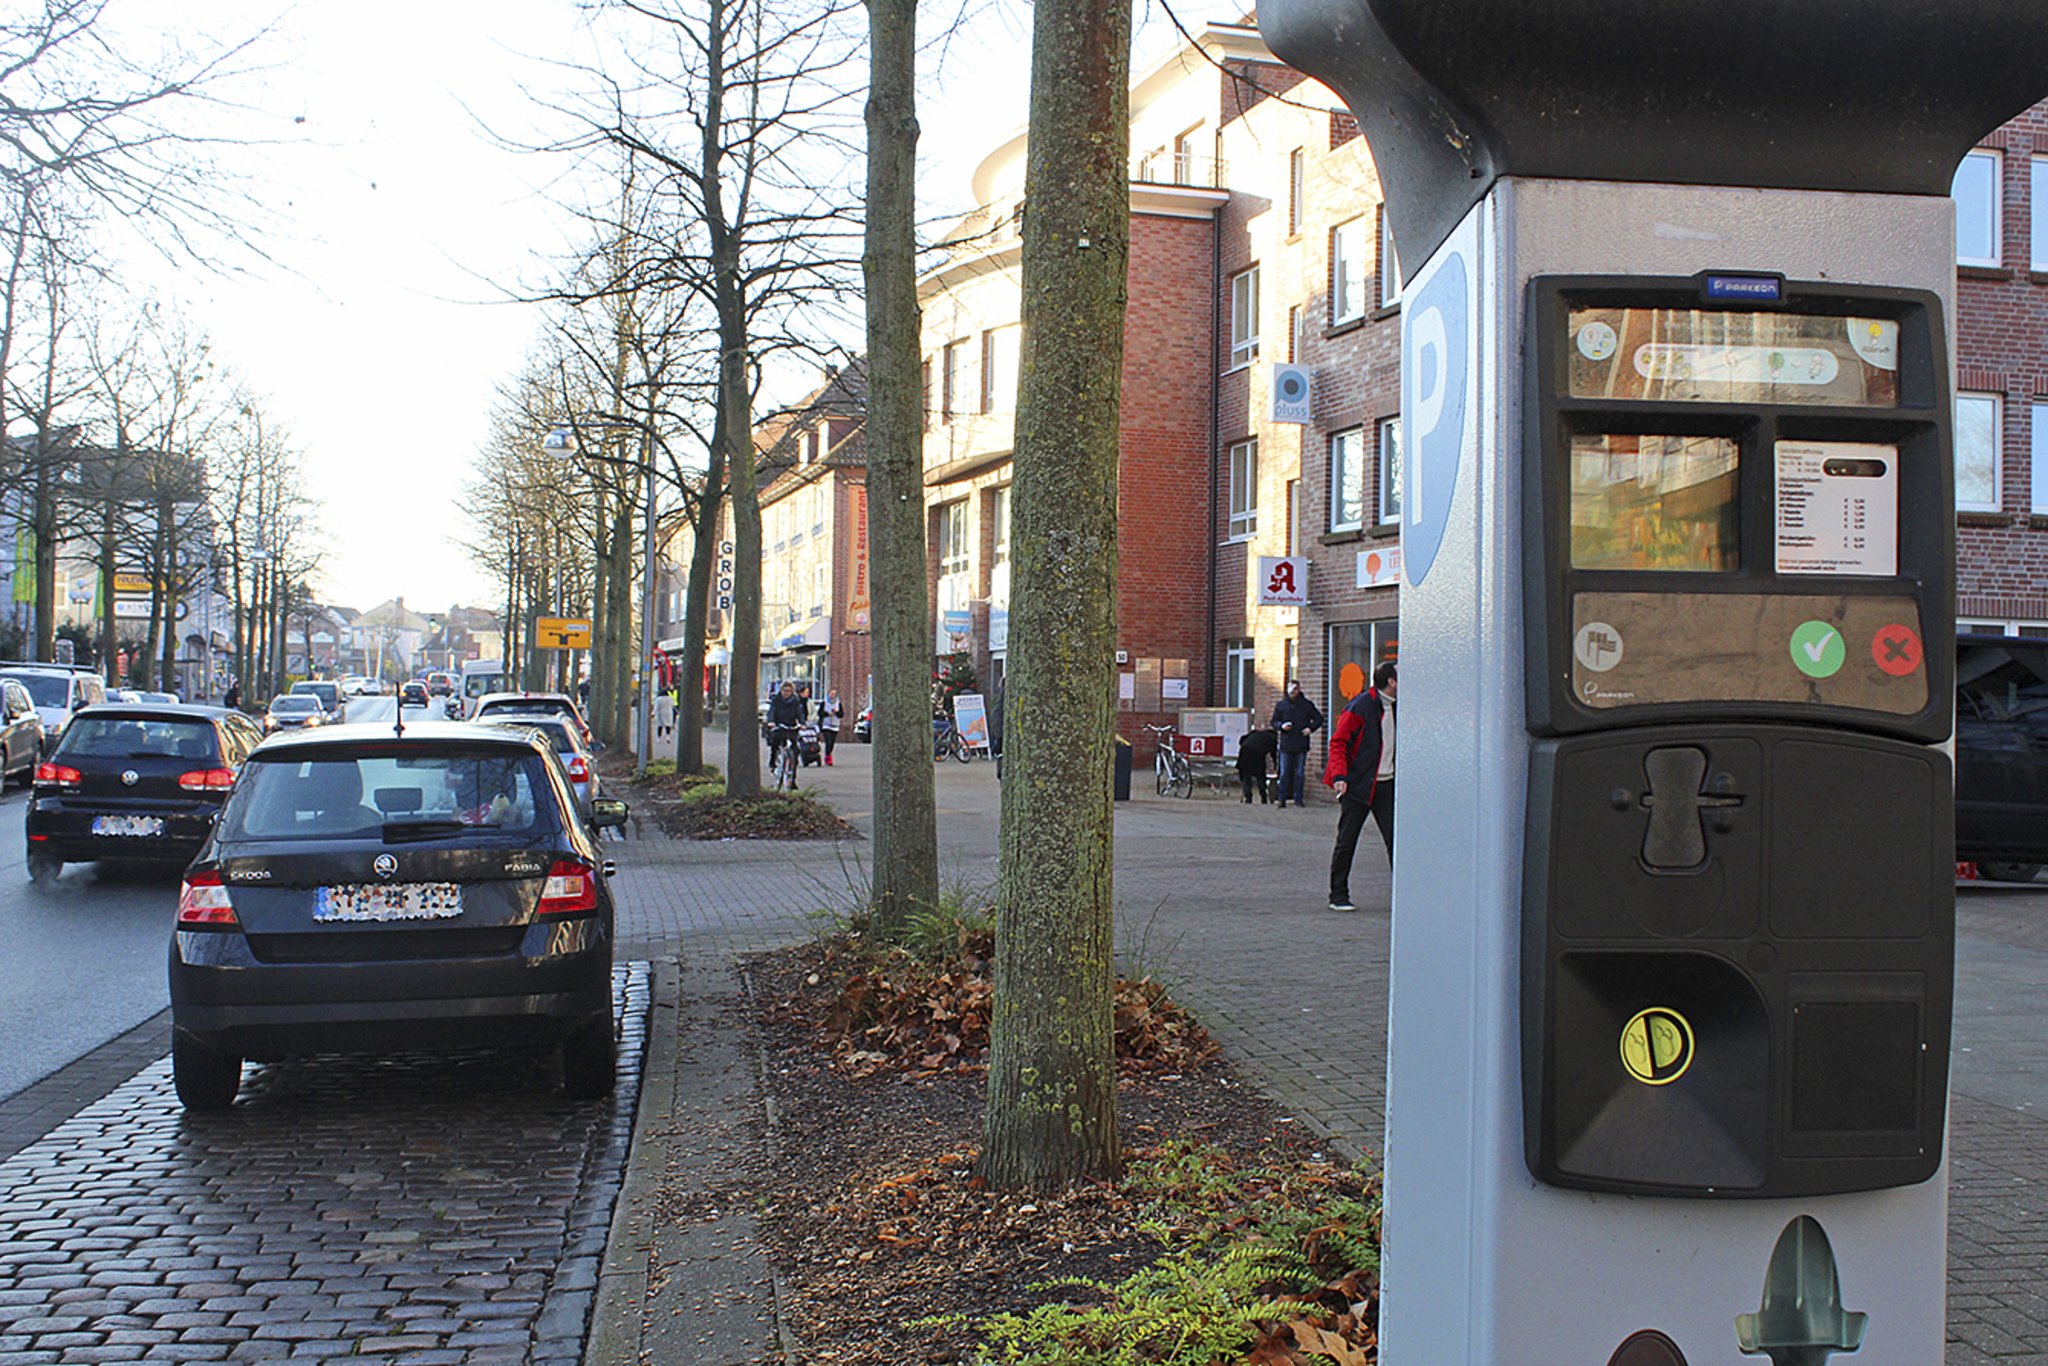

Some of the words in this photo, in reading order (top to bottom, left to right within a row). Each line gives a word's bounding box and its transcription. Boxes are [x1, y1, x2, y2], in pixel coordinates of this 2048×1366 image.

[1725, 283, 1777, 293] PARKEON
[1276, 403, 1307, 417] pluss
[1411, 305, 1448, 526] P
[857, 490, 867, 549] Restaurant
[859, 553, 866, 562] &
[720, 541, 733, 609] GROB
[856, 564, 866, 596] Bistro
[504, 863, 541, 872] FABIA
